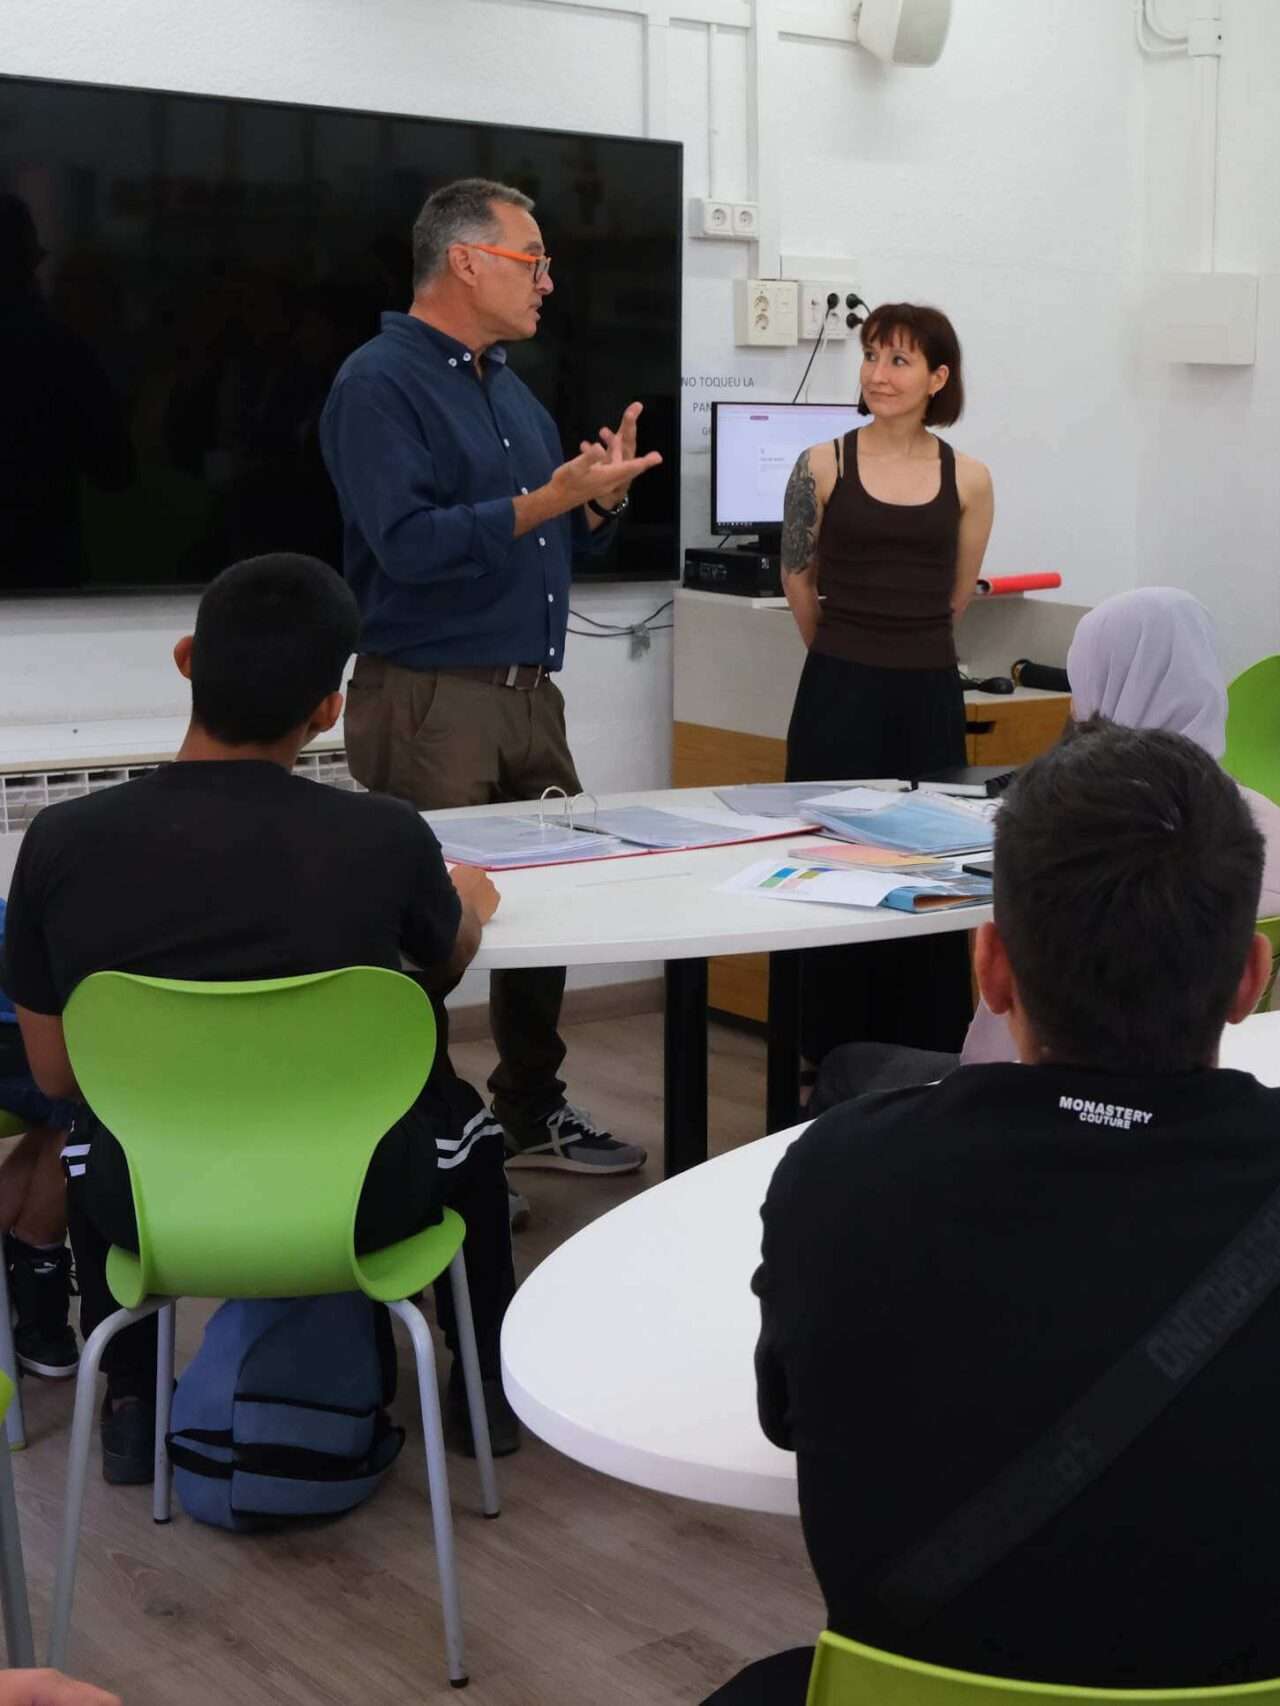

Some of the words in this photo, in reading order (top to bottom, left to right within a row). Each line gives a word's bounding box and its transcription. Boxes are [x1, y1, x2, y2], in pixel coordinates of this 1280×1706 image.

[681, 377, 697, 388] NO
[700, 377, 741, 389] TOQUEU
[743, 377, 755, 388] LA
[1059, 1096, 1153, 1124] MONASTERY
[1079, 1112, 1132, 1130] COUTURE
